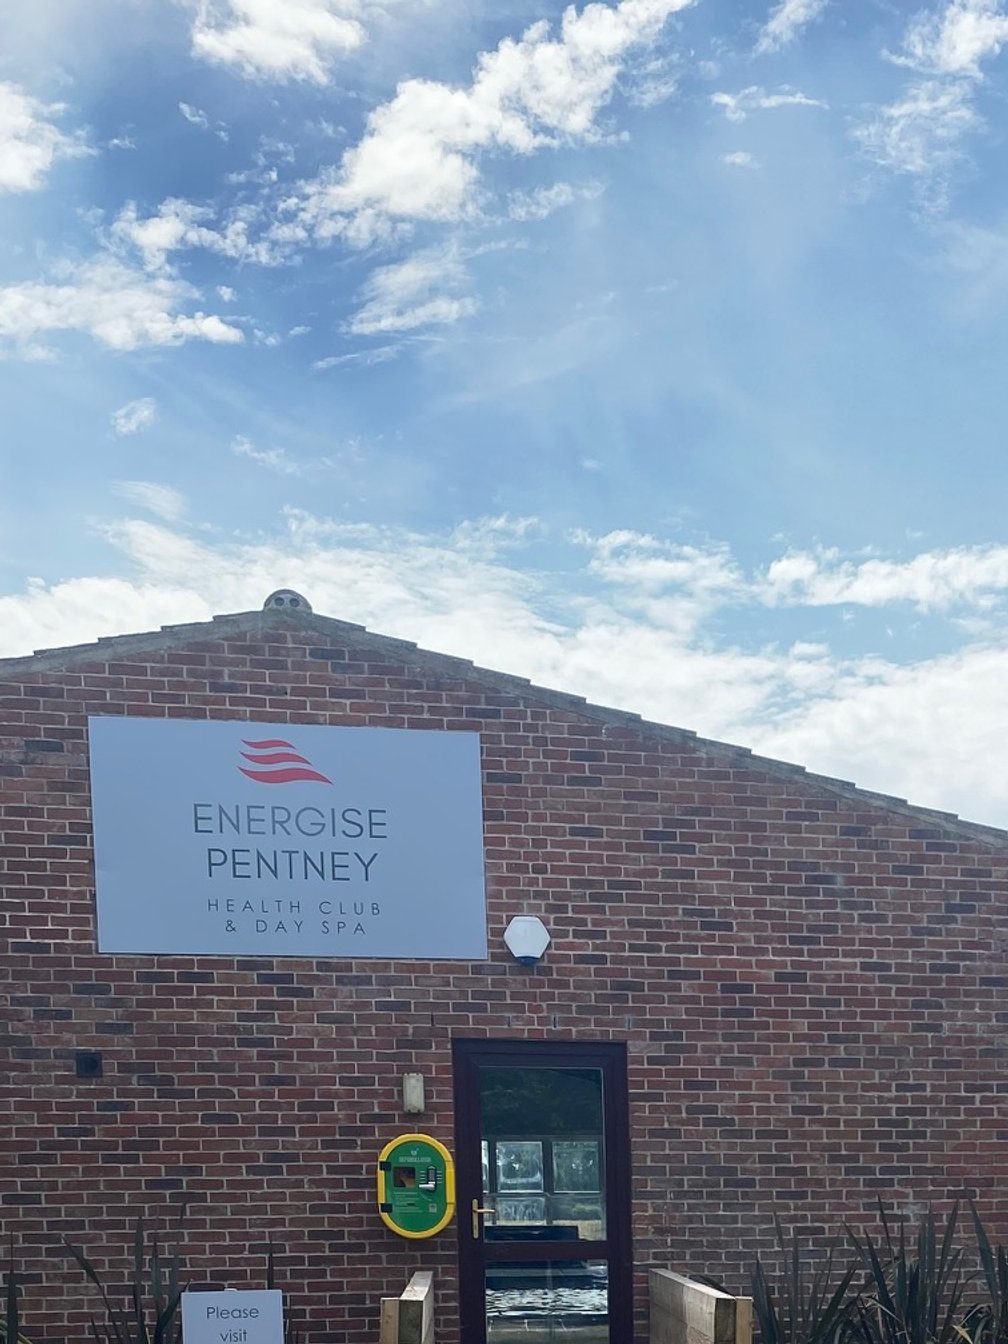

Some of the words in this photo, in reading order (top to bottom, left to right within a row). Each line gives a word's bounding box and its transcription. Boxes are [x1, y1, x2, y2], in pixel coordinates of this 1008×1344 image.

[193, 803, 388, 839] ENERGISE
[207, 847, 379, 882] PENTNEY
[207, 898, 301, 914] HEALTH
[318, 900, 381, 916] CLUB
[225, 919, 237, 933] &
[255, 919, 304, 934] DAY
[321, 920, 366, 935] SPA
[206, 1306, 260, 1320] Please
[219, 1328, 248, 1342] visit
